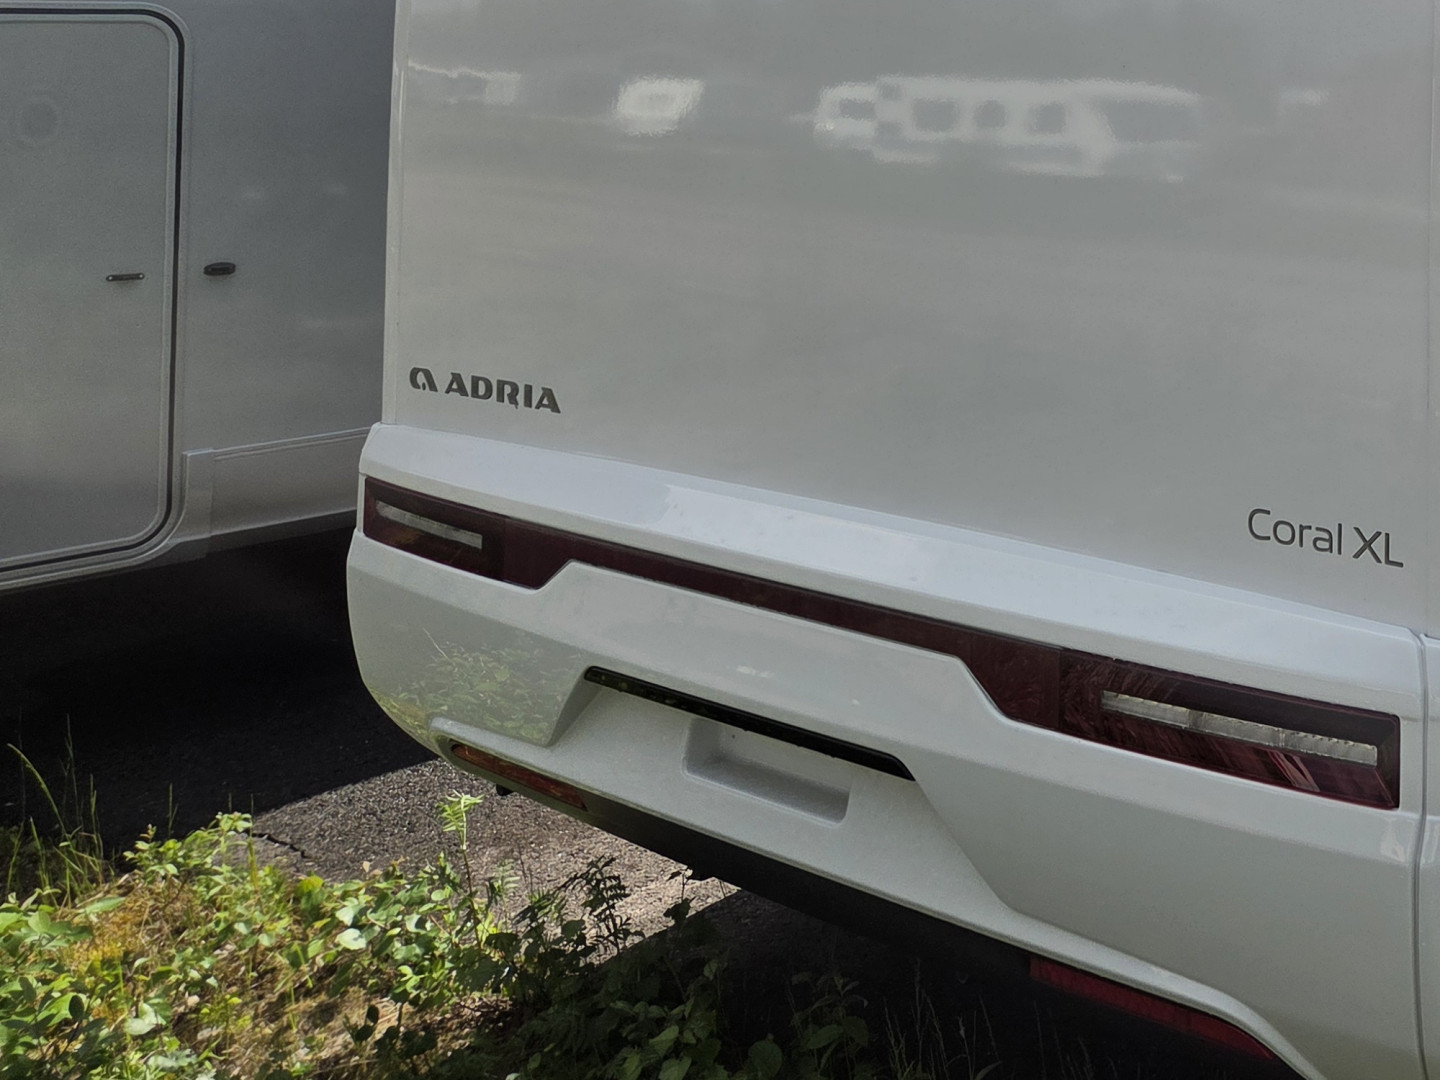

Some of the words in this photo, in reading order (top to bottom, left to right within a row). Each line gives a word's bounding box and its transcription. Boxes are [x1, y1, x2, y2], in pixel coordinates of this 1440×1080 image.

[444, 372, 562, 414] ADRIA
[1248, 508, 1342, 555] Coral
[1352, 526, 1404, 568] XL
